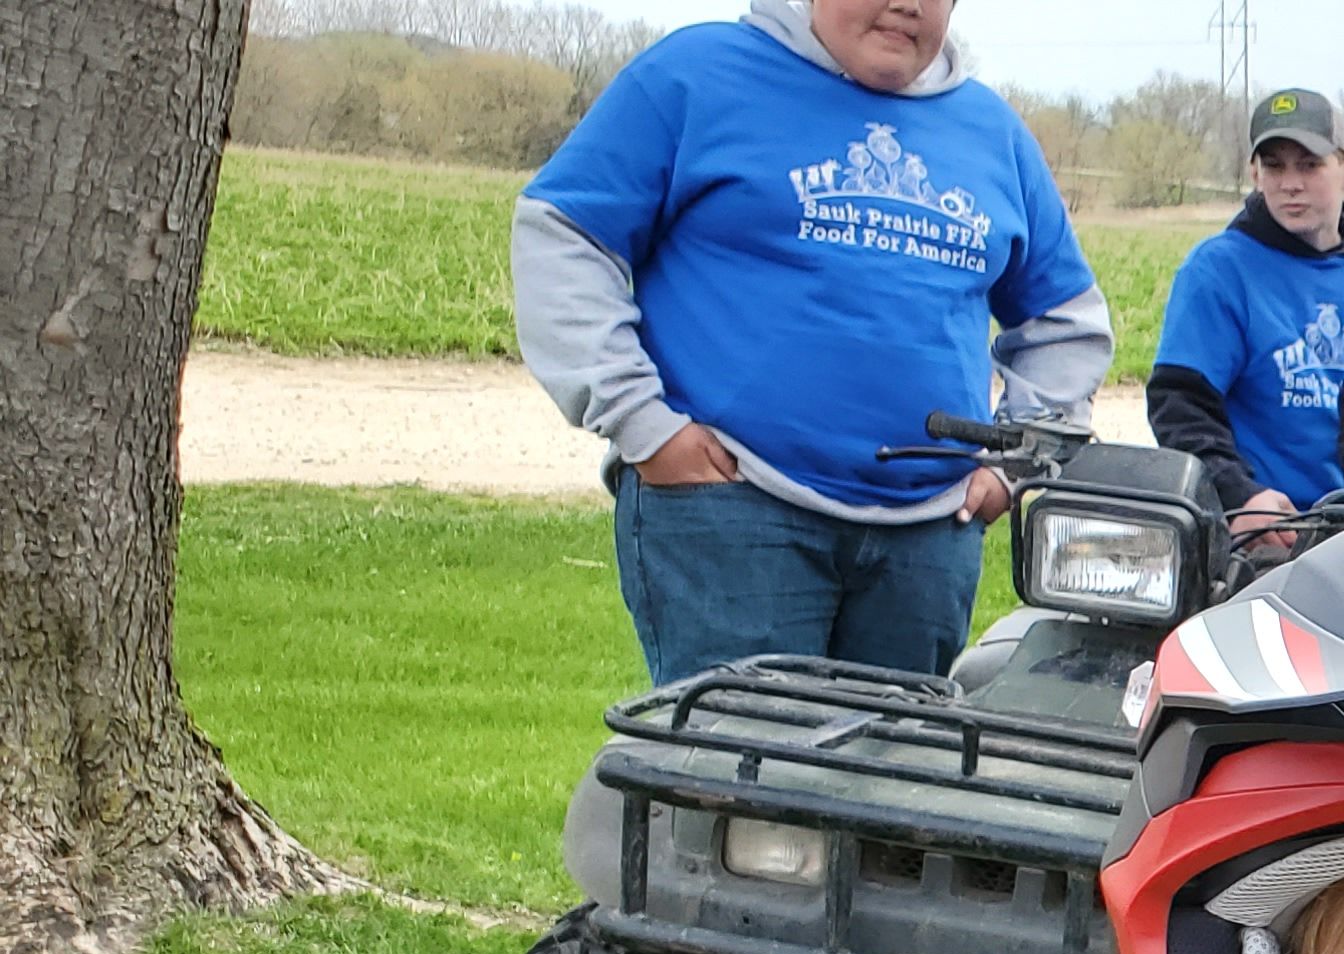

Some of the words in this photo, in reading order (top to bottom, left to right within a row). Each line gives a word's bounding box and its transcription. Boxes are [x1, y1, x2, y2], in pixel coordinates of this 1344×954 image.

[798, 221, 857, 245] Food
[862, 228, 900, 253] For
[903, 237, 987, 274] America
[804, 199, 861, 224] Sauk
[866, 208, 941, 240] Prairie
[945, 223, 987, 251] FFA
[1282, 391, 1322, 408] Food
